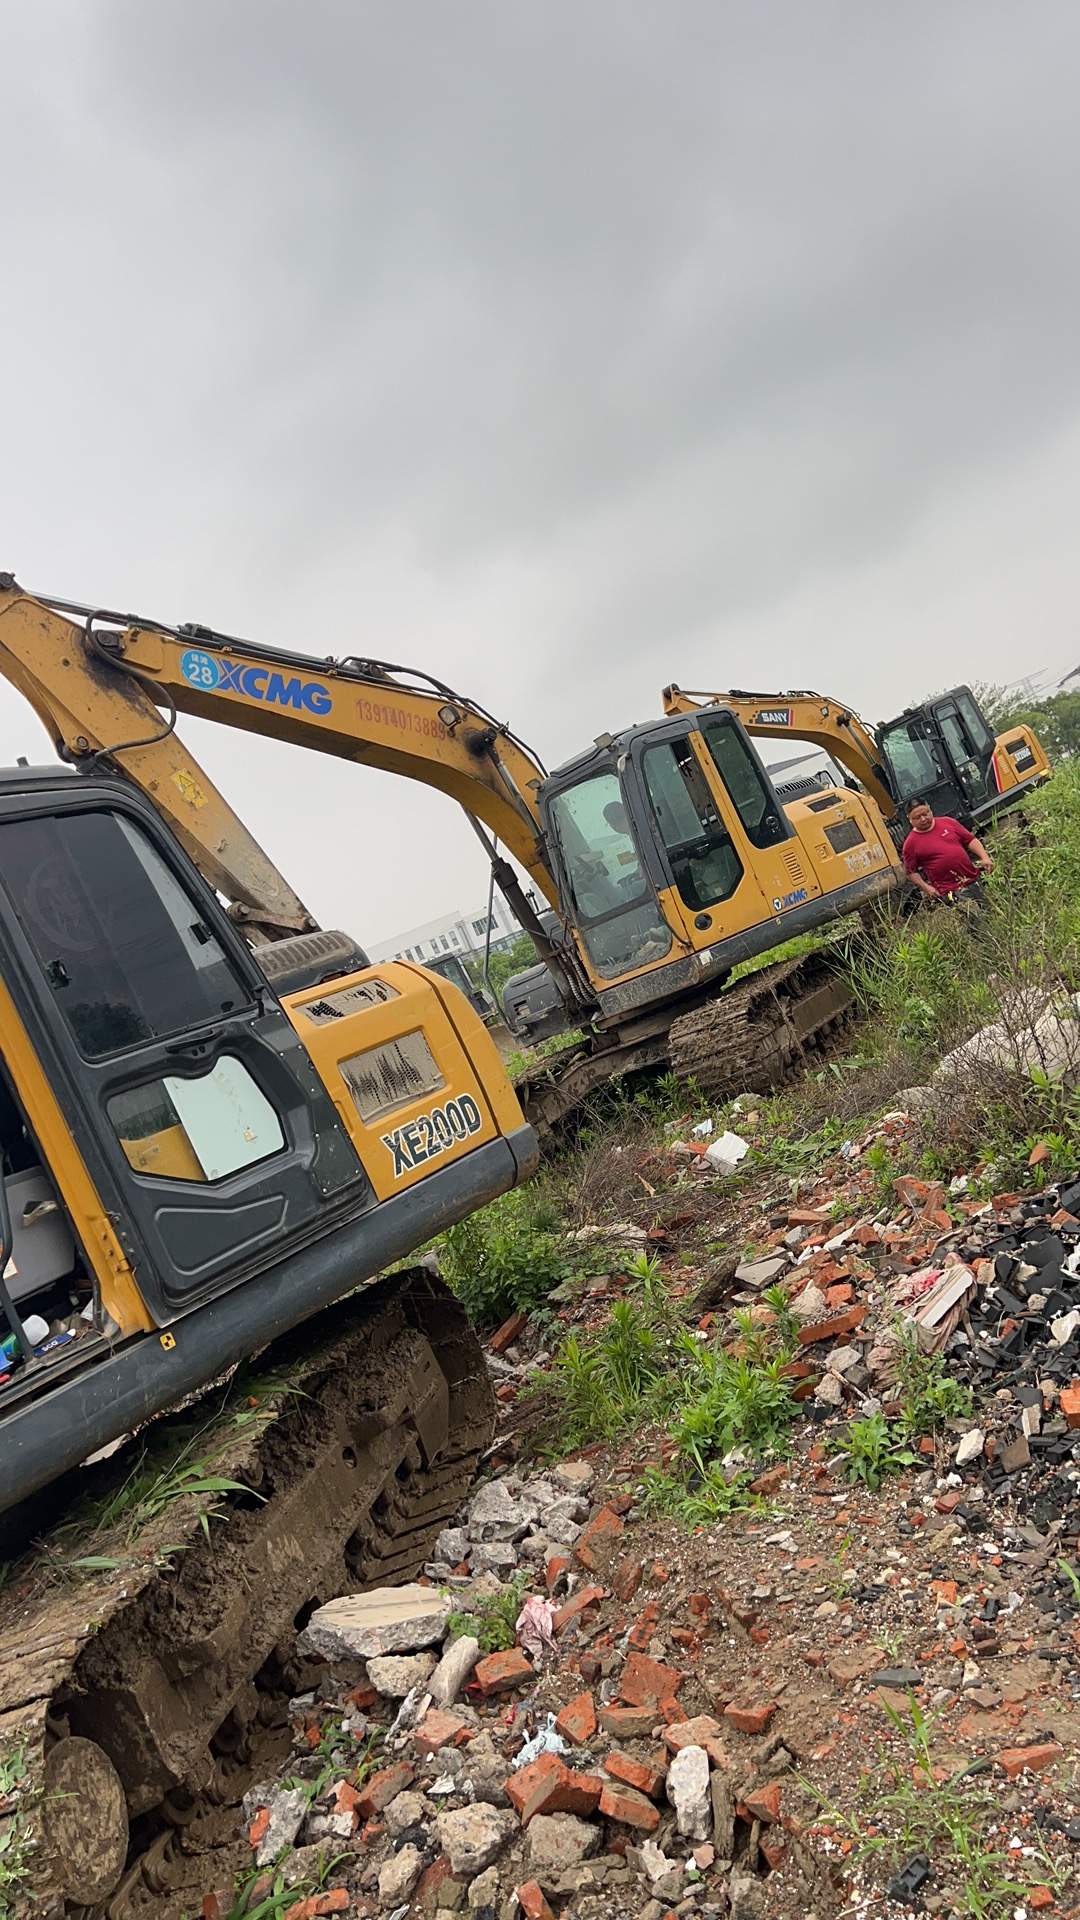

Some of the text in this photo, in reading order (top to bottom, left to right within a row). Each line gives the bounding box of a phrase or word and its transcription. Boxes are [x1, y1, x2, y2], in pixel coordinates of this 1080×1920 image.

[188, 663, 213, 685] 28
[217, 659, 333, 716] XCMG
[761, 712, 787, 723] SANY
[379, 1093, 482, 1179] XE200D
